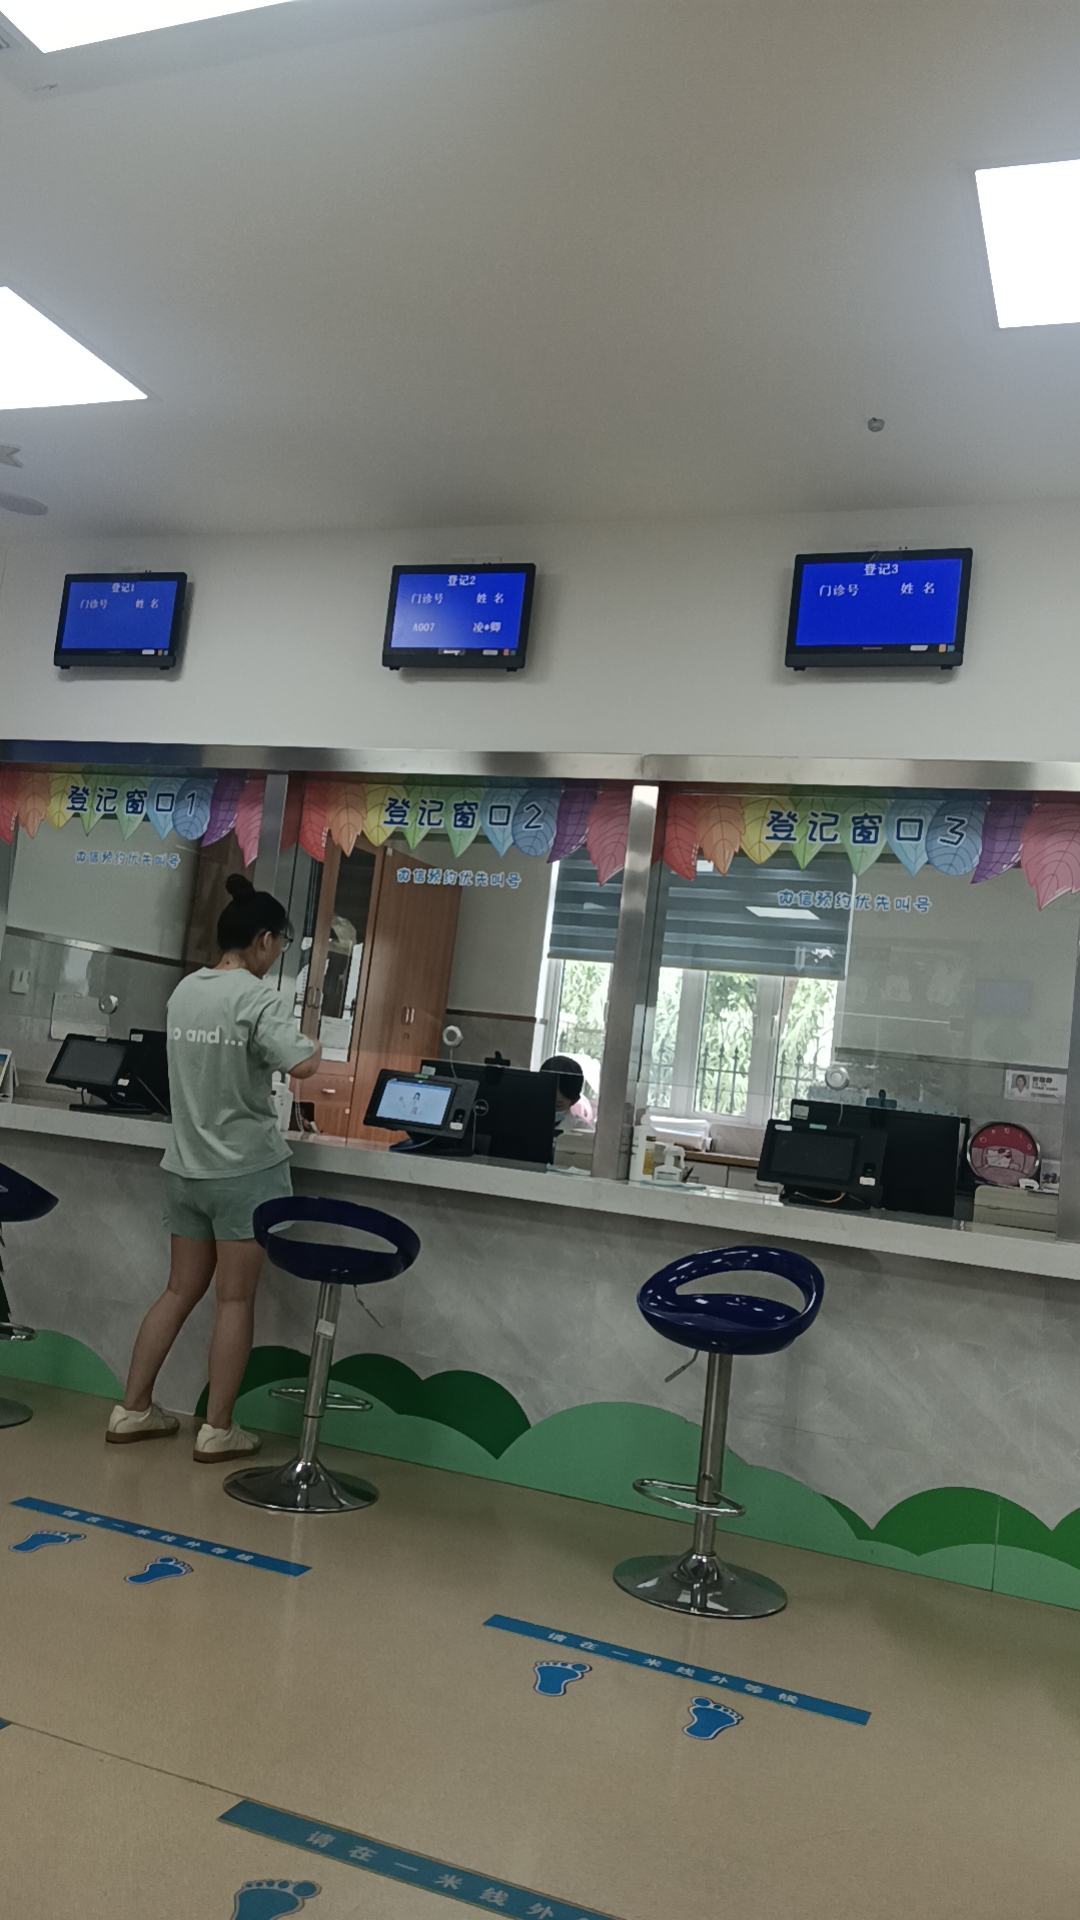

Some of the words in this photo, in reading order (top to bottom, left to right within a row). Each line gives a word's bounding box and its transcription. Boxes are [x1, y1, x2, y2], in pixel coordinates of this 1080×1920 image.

[863, 563, 899, 576] 登记3
[111, 582, 135, 593] 登记1
[447, 574, 476, 586] 登记2
[411, 593, 444, 604] 门诊号
[819, 584, 859, 597] 门诊号
[412, 622, 435, 632] A007
[66, 785, 197, 817] 登记窗口1
[382, 797, 543, 830] 登记窗口2
[765, 810, 968, 847] 登记窗口3
[397, 867, 522, 889] 微信预约优先叫号
[777, 889, 932, 913] 微信预约优先叫号
[185, 1025, 220, 1044] and
[547, 1632, 799, 1705] 请在一米线外等候
[305, 1830, 588, 1920] 请在一米线外
